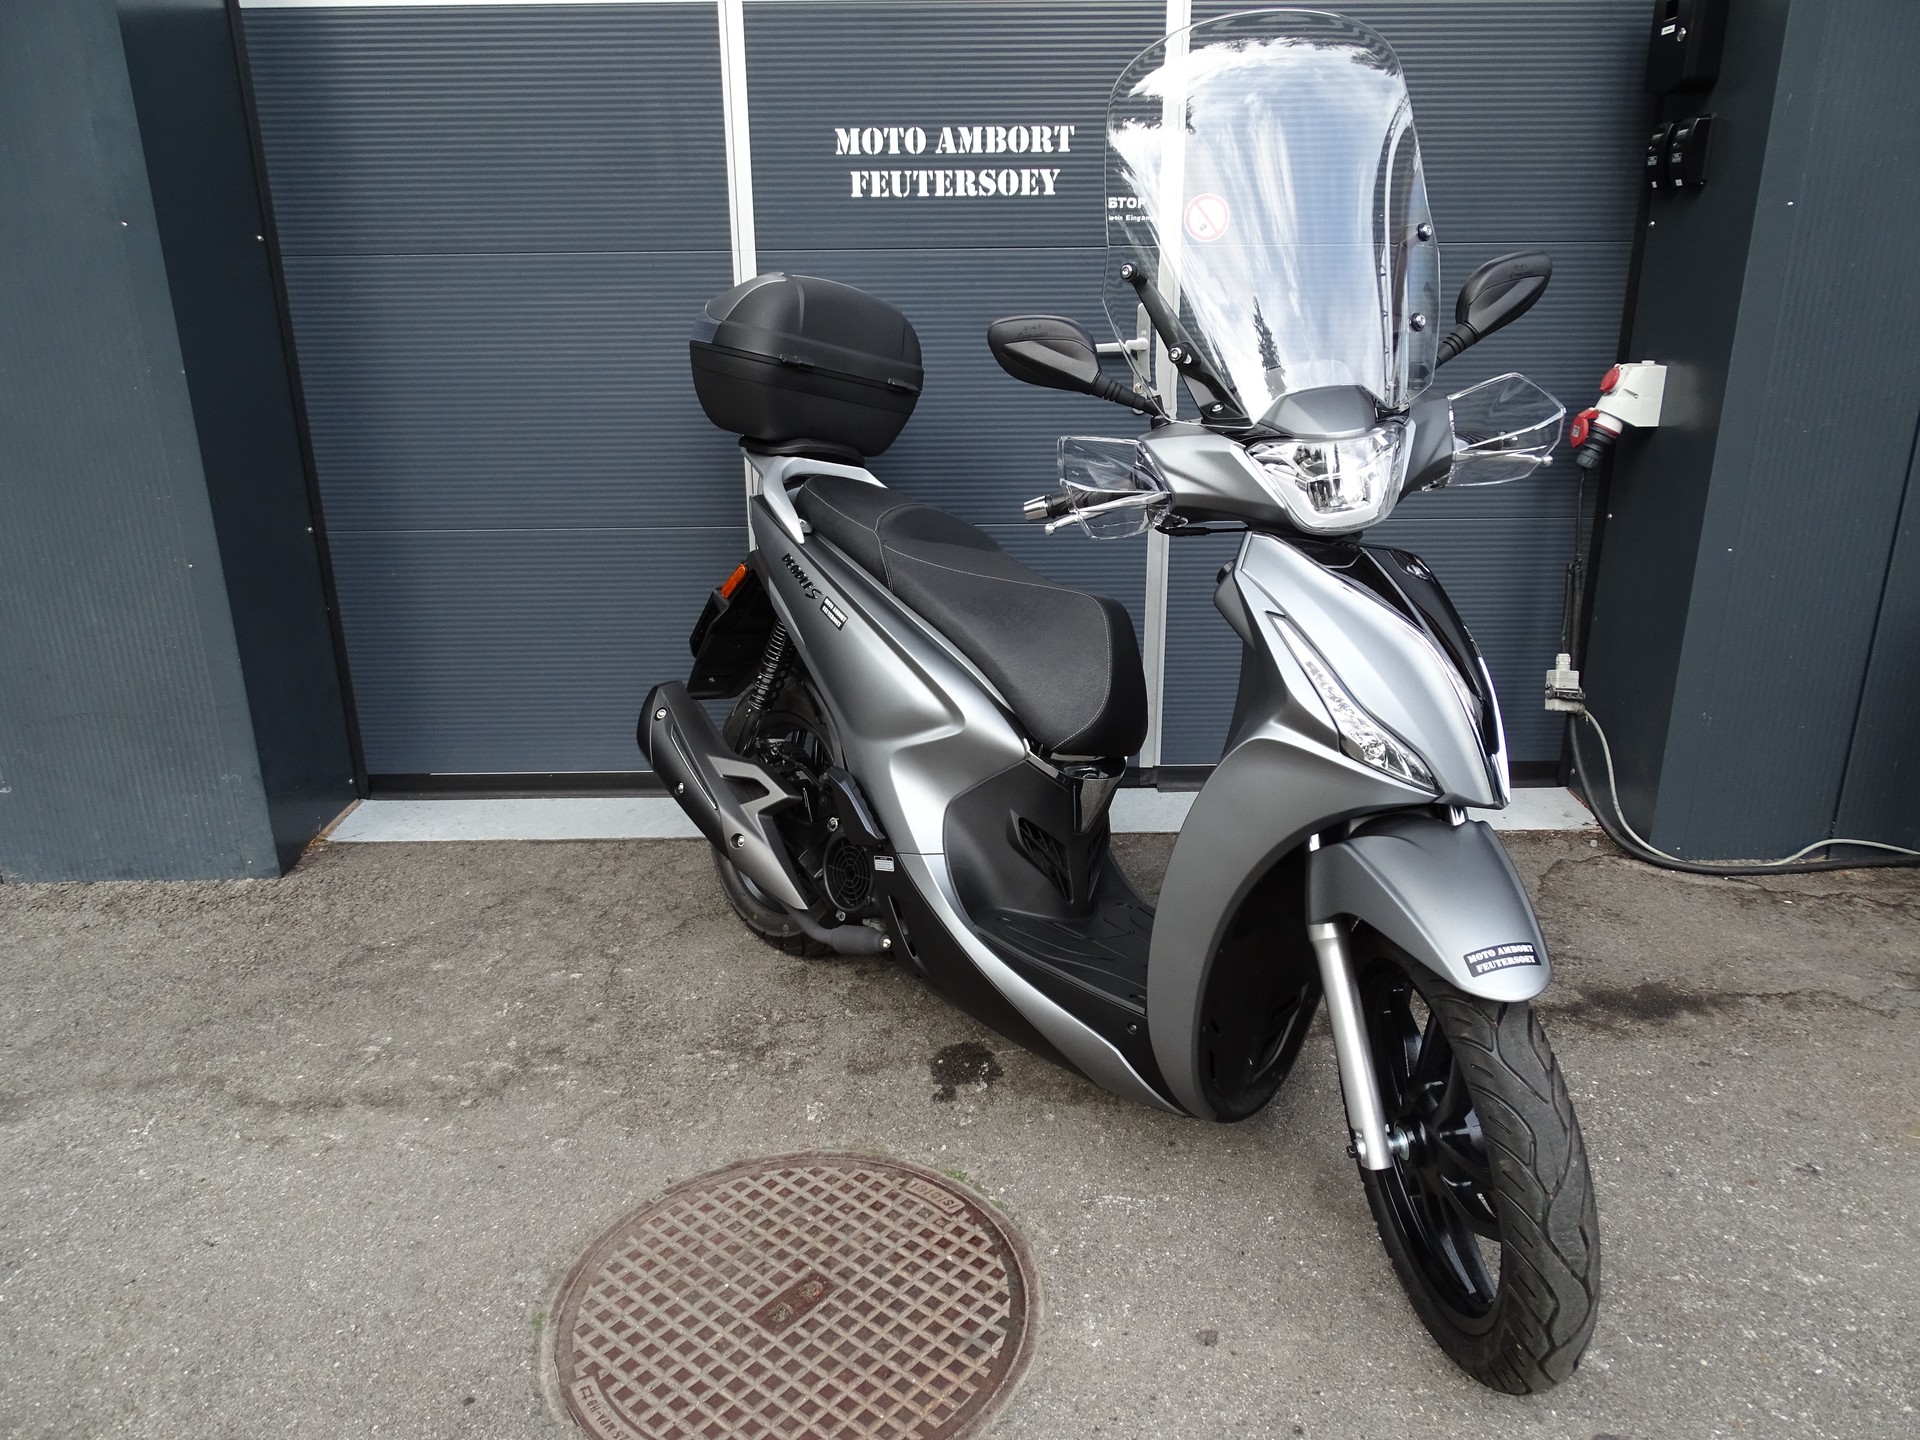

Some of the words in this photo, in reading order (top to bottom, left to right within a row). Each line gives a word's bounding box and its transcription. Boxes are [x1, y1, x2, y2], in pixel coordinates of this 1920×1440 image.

[835, 127, 927, 155] MOTO
[935, 125, 1075, 154] AMBORT
[850, 168, 1061, 198] FEUTERSOEY
[1108, 197, 1146, 209] STOP
[1467, 949, 1496, 963] MOTO
[1497, 945, 1534, 956] AMBORT
[1476, 955, 1535, 973] FEUTERSOEY
